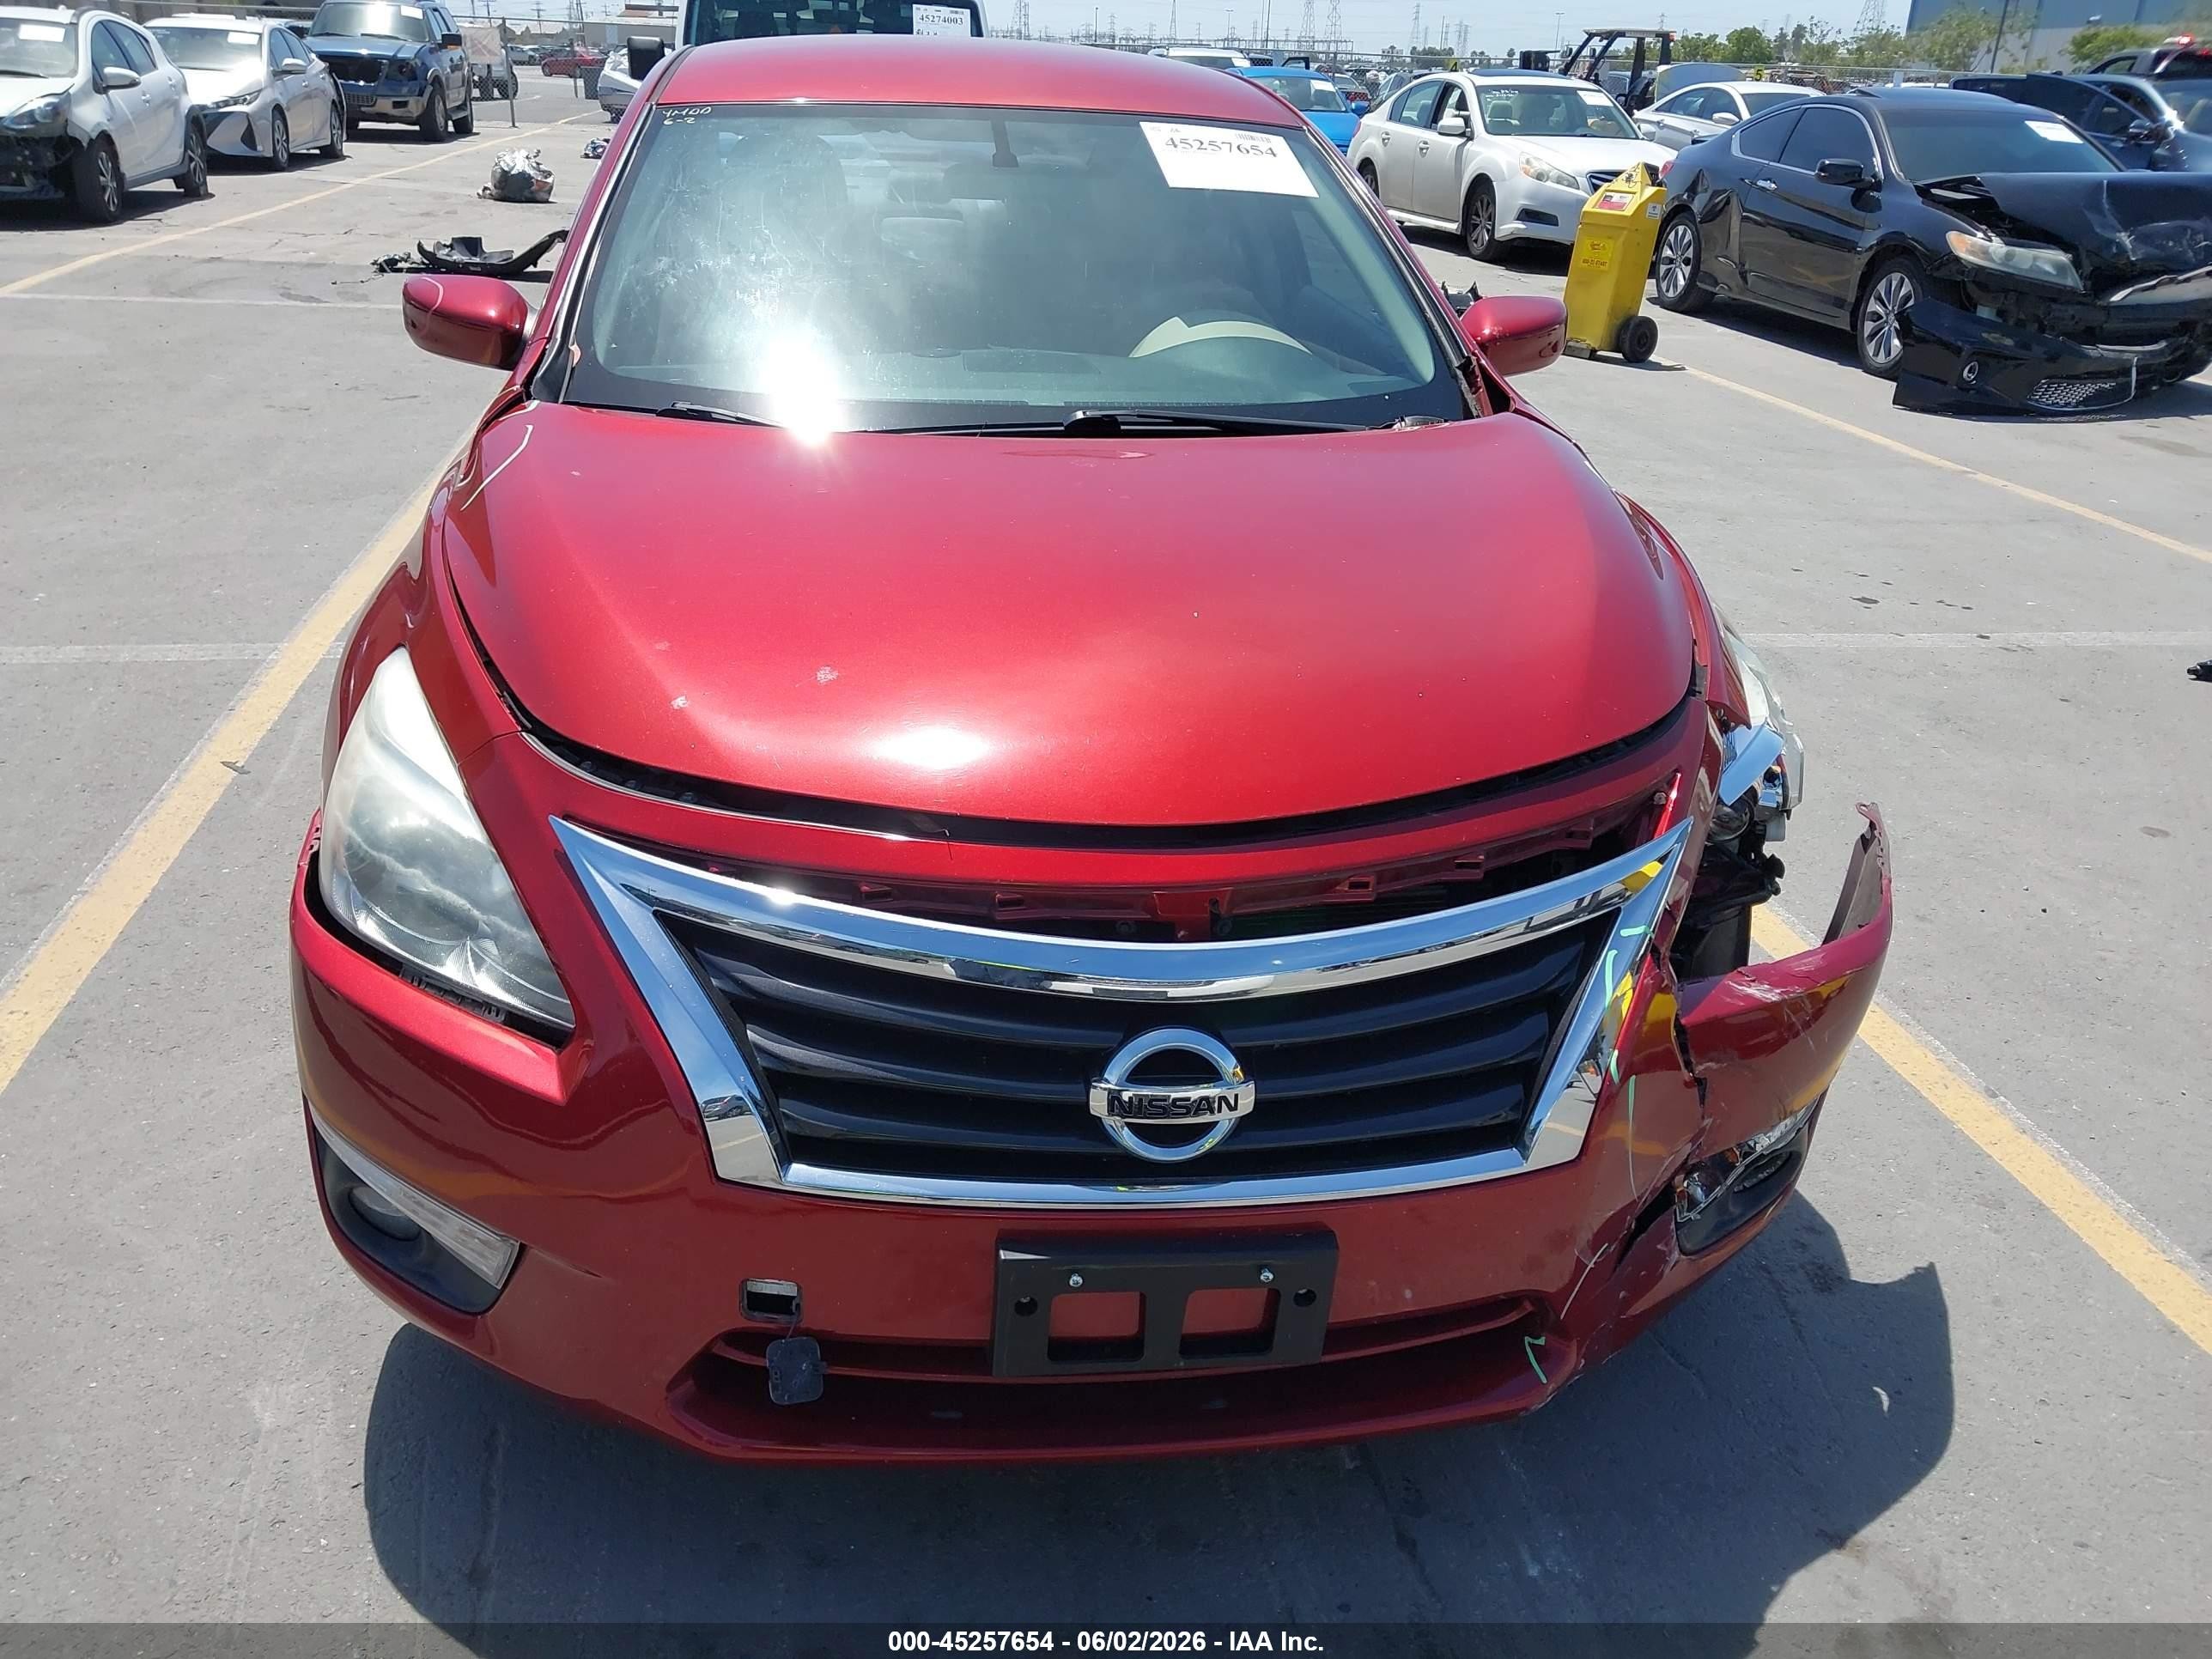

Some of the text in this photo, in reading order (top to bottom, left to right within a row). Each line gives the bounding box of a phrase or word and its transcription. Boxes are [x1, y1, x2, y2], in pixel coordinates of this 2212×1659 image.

[919, 13, 963, 26] 45274003
[1450, 61, 1459, 73] 4
[1754, 69, 1763, 82] 5
[1164, 137, 1279, 158] 45257654
[1109, 1092, 1239, 1119] NISSAN
